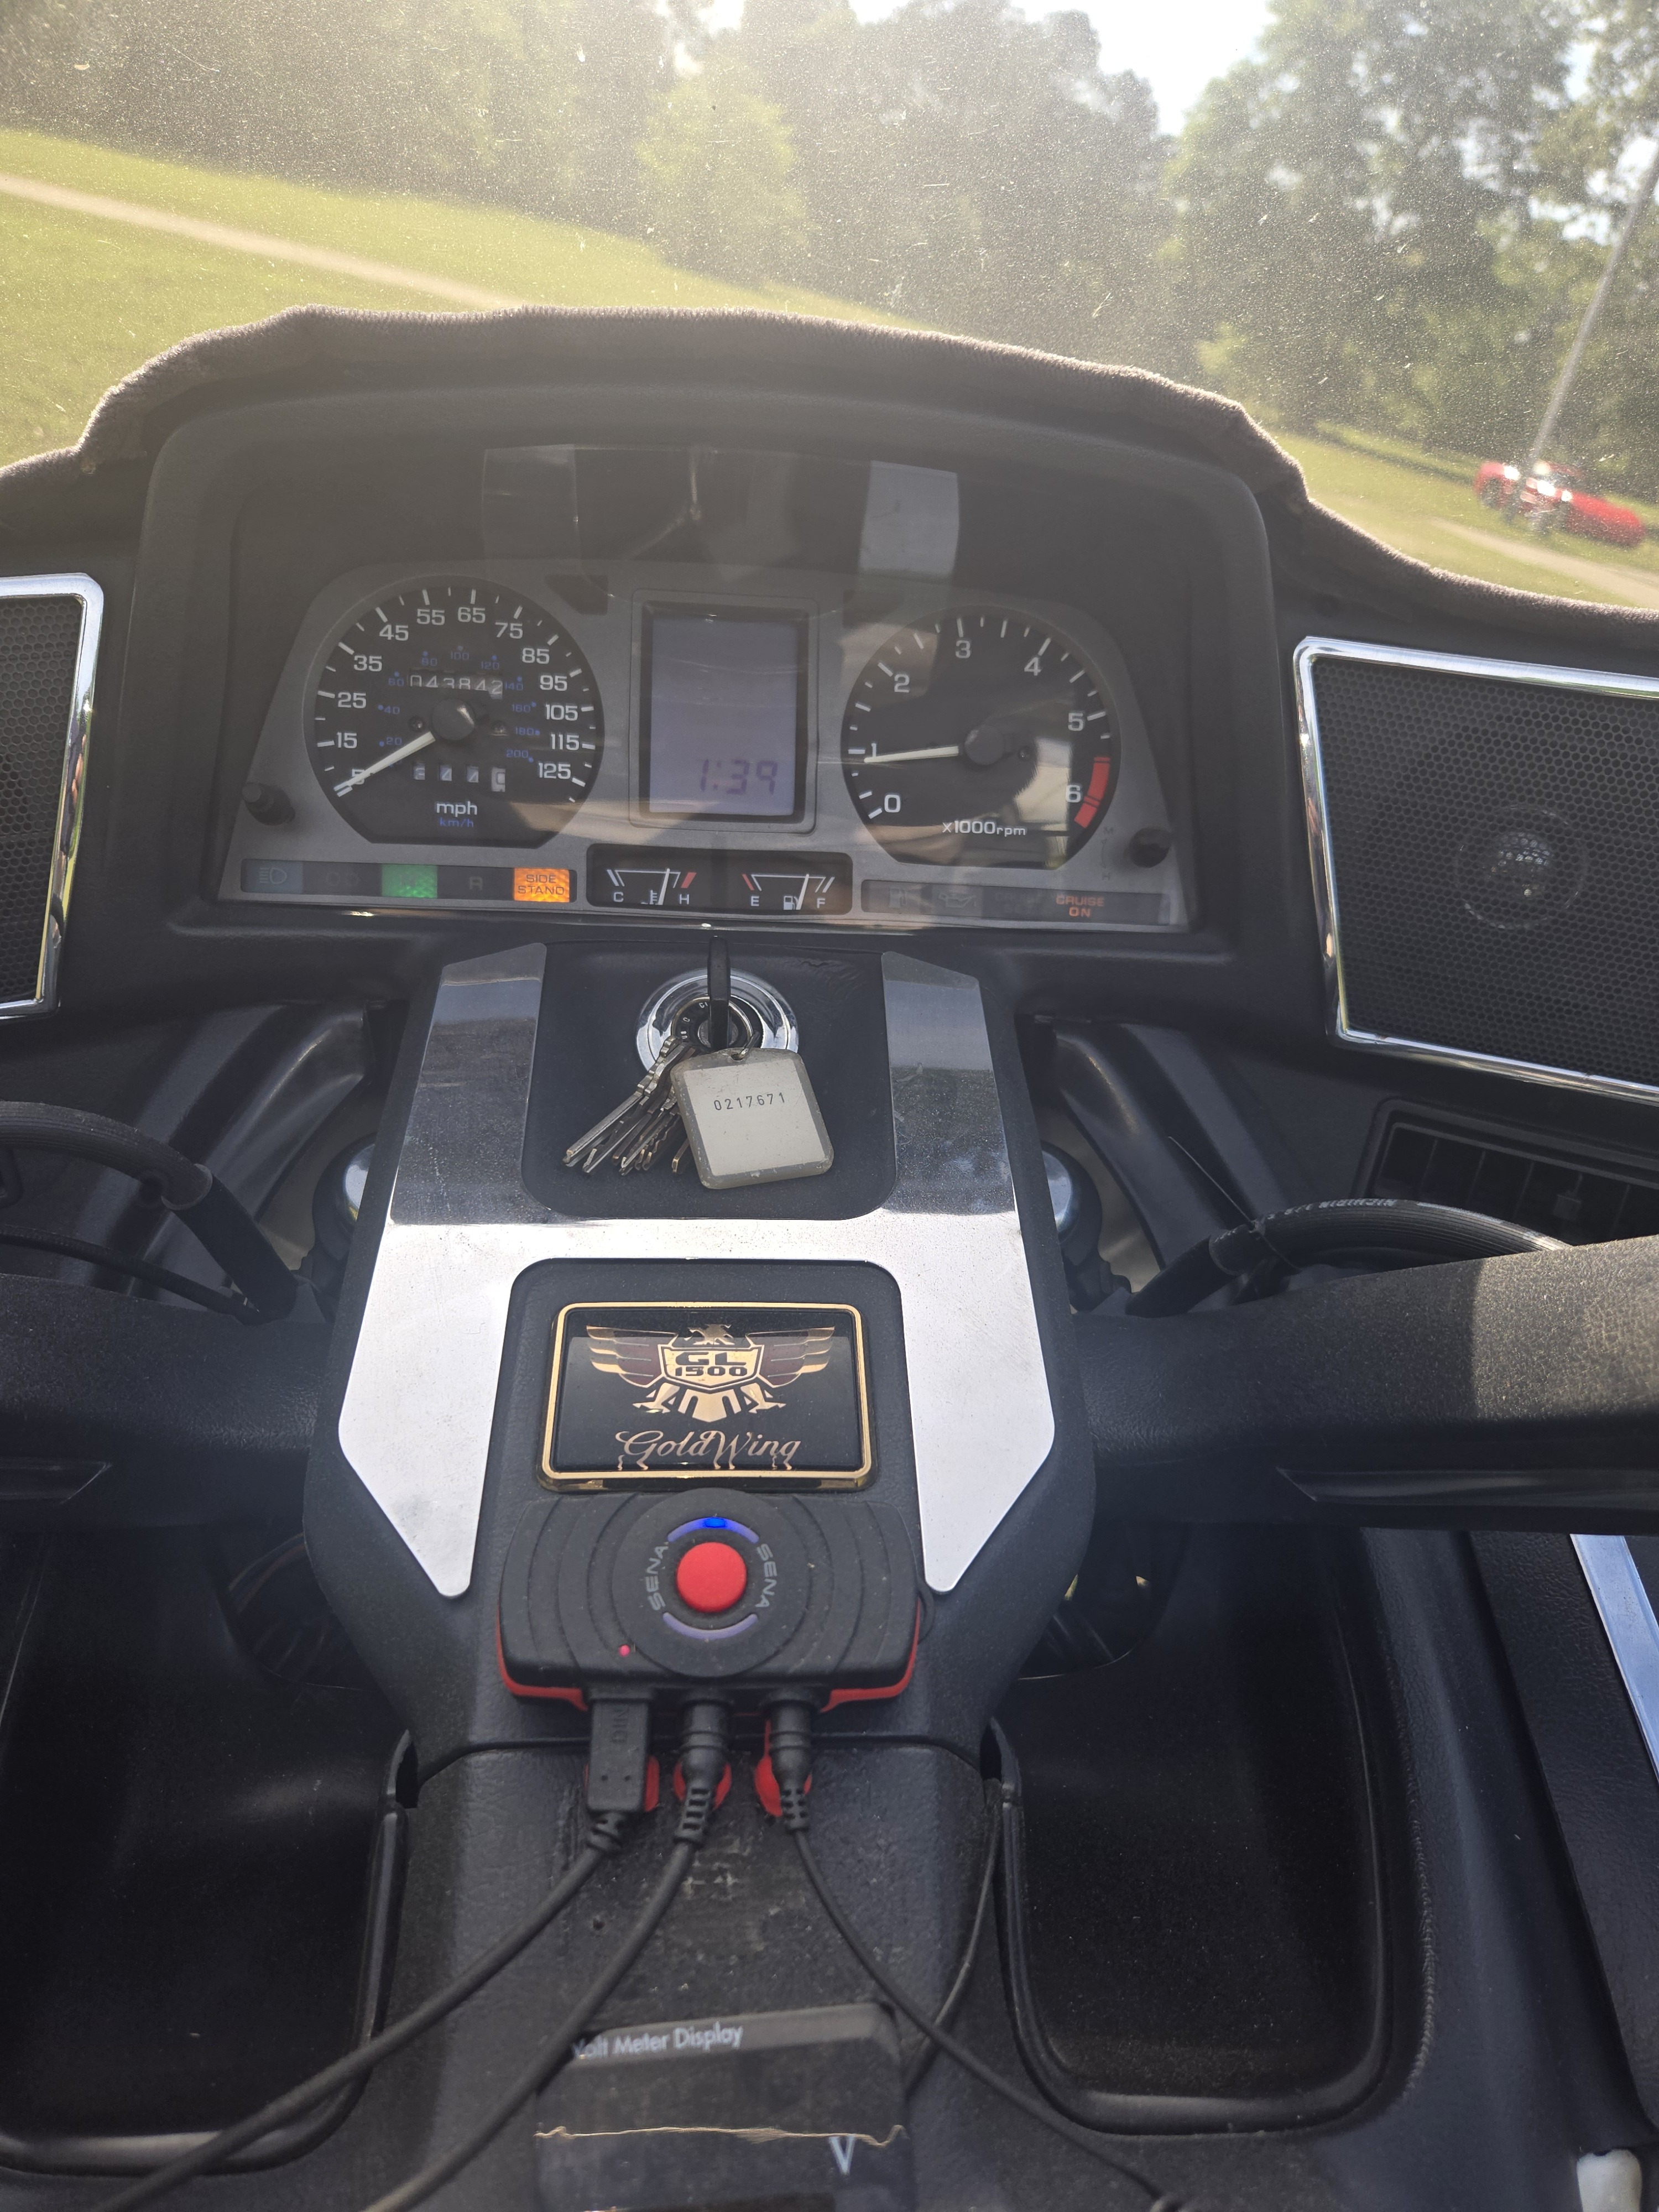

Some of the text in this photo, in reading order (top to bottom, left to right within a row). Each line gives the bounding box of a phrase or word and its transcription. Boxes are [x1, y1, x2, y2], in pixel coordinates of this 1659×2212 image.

[416, 609, 445, 625] 55
[458, 607, 486, 623] 65
[379, 625, 409, 641] 45
[496, 622, 523, 639] 75
[450, 651, 469, 660] 100
[521, 648, 549, 664] 85
[955, 640, 971, 658] 3
[353, 655, 382, 672] 35
[481, 661, 500, 670] 120
[1024, 658, 1041, 676] 4
[505, 682, 523, 690] 140
[540, 675, 567, 691] 95
[894, 674, 910, 692] 2
[338, 692, 367, 708] 25
[384, 706, 400, 714] 40
[546, 704, 578, 721] 105
[1068, 713, 1083, 731] 5
[515, 726, 534, 735] 180
[337, 732, 357, 748] 15
[387, 737, 403, 745] 20
[551, 733, 580, 750] 115
[506, 749, 529, 758] 200
[539, 763, 571, 779] 125
[701, 759, 778, 795] 1:39
[1066, 784, 1082, 803] 6
[436, 801, 478, 817] mph
[885, 795, 901, 813] 0
[440, 817, 474, 827] km/h
[526, 874, 556, 884] SIDE
[518, 885, 564, 895] STAND
[613, 891, 624, 902] C
[679, 894, 690, 905] H
[750, 896, 759, 907] E
[817, 898, 826, 909] F
[1056, 894, 1104, 907] CRUISE
[1069, 906, 1091, 918] ON
[714, 1092, 785, 1110] 0217671
[676, 1351, 746, 1366] GL
[675, 1366, 747, 1377] 1500
[645, 1545, 669, 1611] SENA
[755, 1543, 778, 1608] SENA
[613, 2033, 670, 2054] Meter
[673, 2021, 744, 2052] Display
[830, 2134, 856, 2175] V
